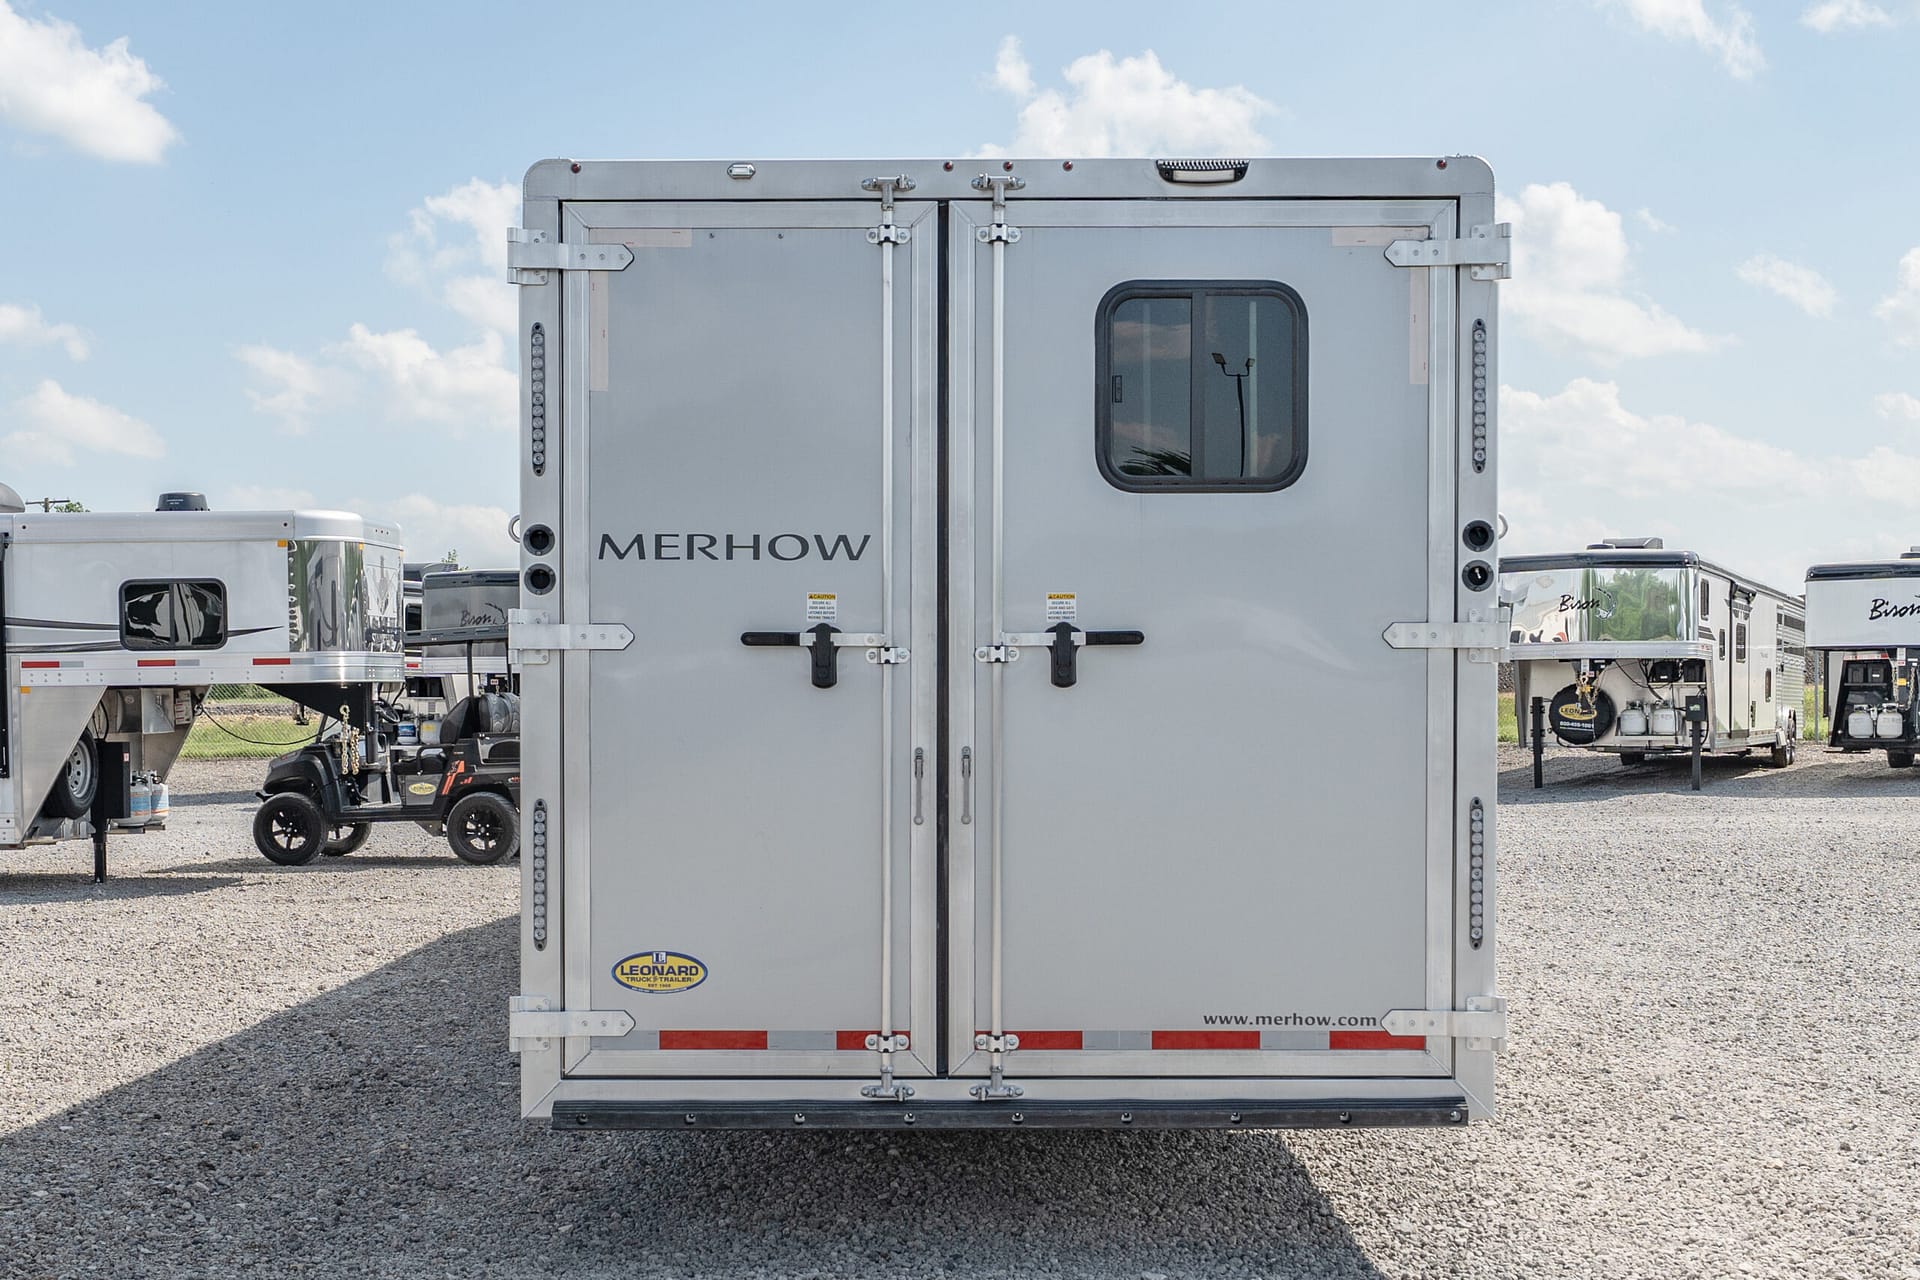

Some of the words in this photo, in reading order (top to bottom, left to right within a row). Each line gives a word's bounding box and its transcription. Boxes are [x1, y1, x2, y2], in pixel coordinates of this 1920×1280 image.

[598, 533, 871, 560] MERHOW
[1559, 594, 1600, 612] Bison
[1869, 598, 1920, 620] Bison
[620, 965, 699, 976] LEONARD
[1203, 1013, 1377, 1026] www.merhow.com
